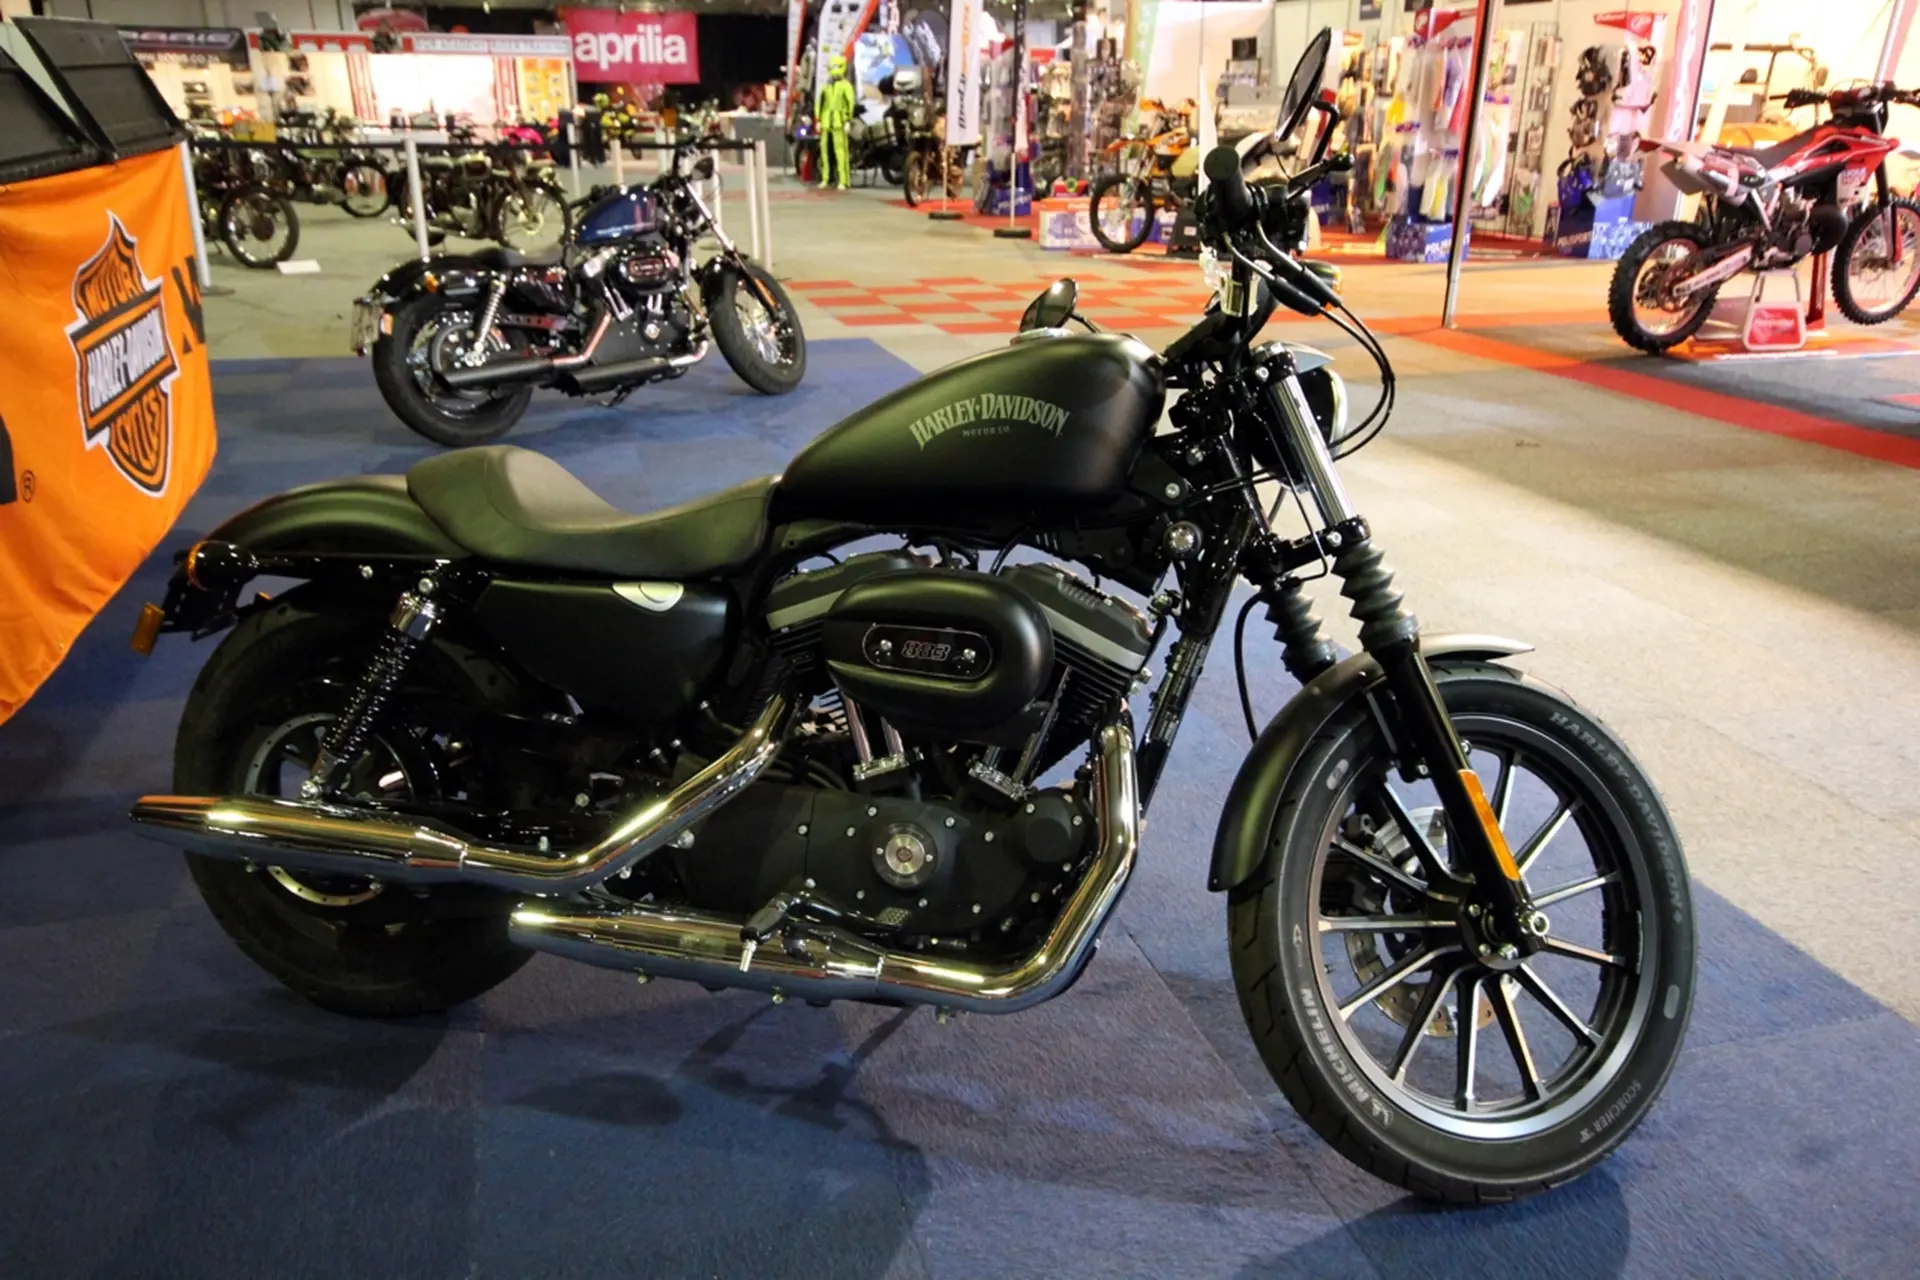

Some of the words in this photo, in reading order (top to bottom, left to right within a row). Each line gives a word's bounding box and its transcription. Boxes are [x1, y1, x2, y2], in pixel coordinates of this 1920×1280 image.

[576, 24, 688, 71] aprilia
[962, 426, 997, 438] MOTOR
[901, 640, 951, 661] 883
[1300, 987, 1370, 1104] MICHELIN
[1592, 1079, 1642, 1132] SCORCHER
